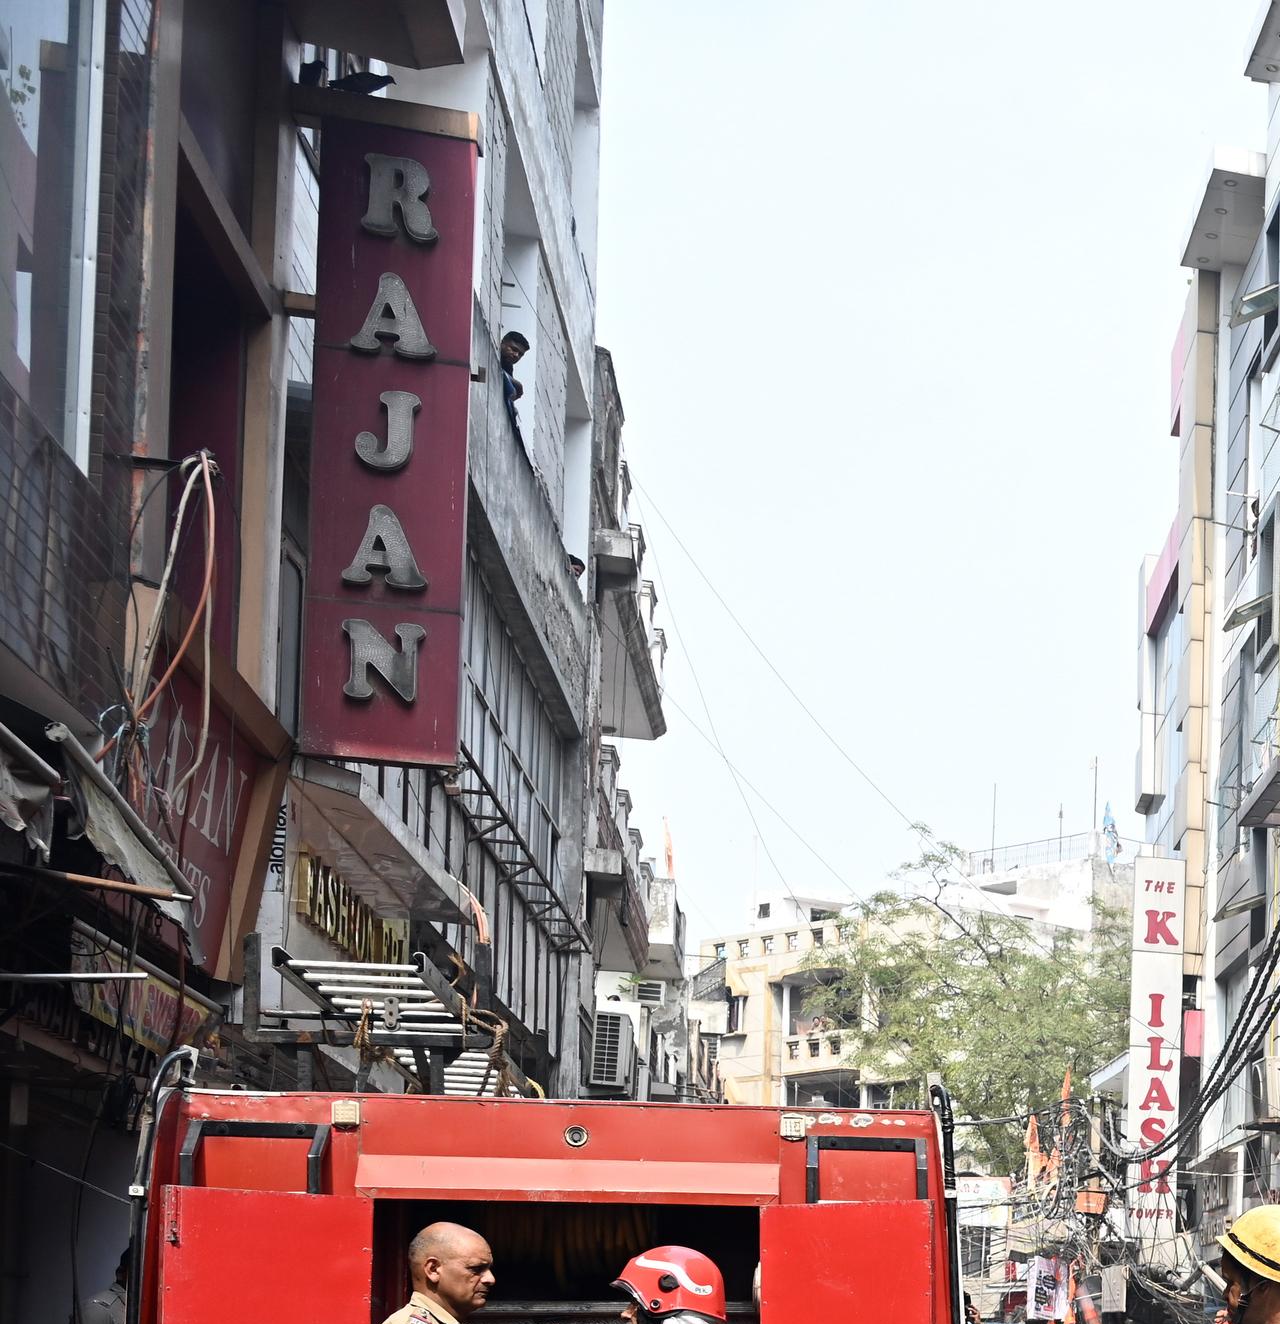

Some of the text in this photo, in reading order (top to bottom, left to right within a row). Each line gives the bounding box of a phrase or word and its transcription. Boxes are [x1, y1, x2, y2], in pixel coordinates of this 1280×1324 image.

[341, 152, 440, 702] RAJAN
[1144, 879, 1176, 894] THE
[1128, 1207, 1174, 1220] TOWER
